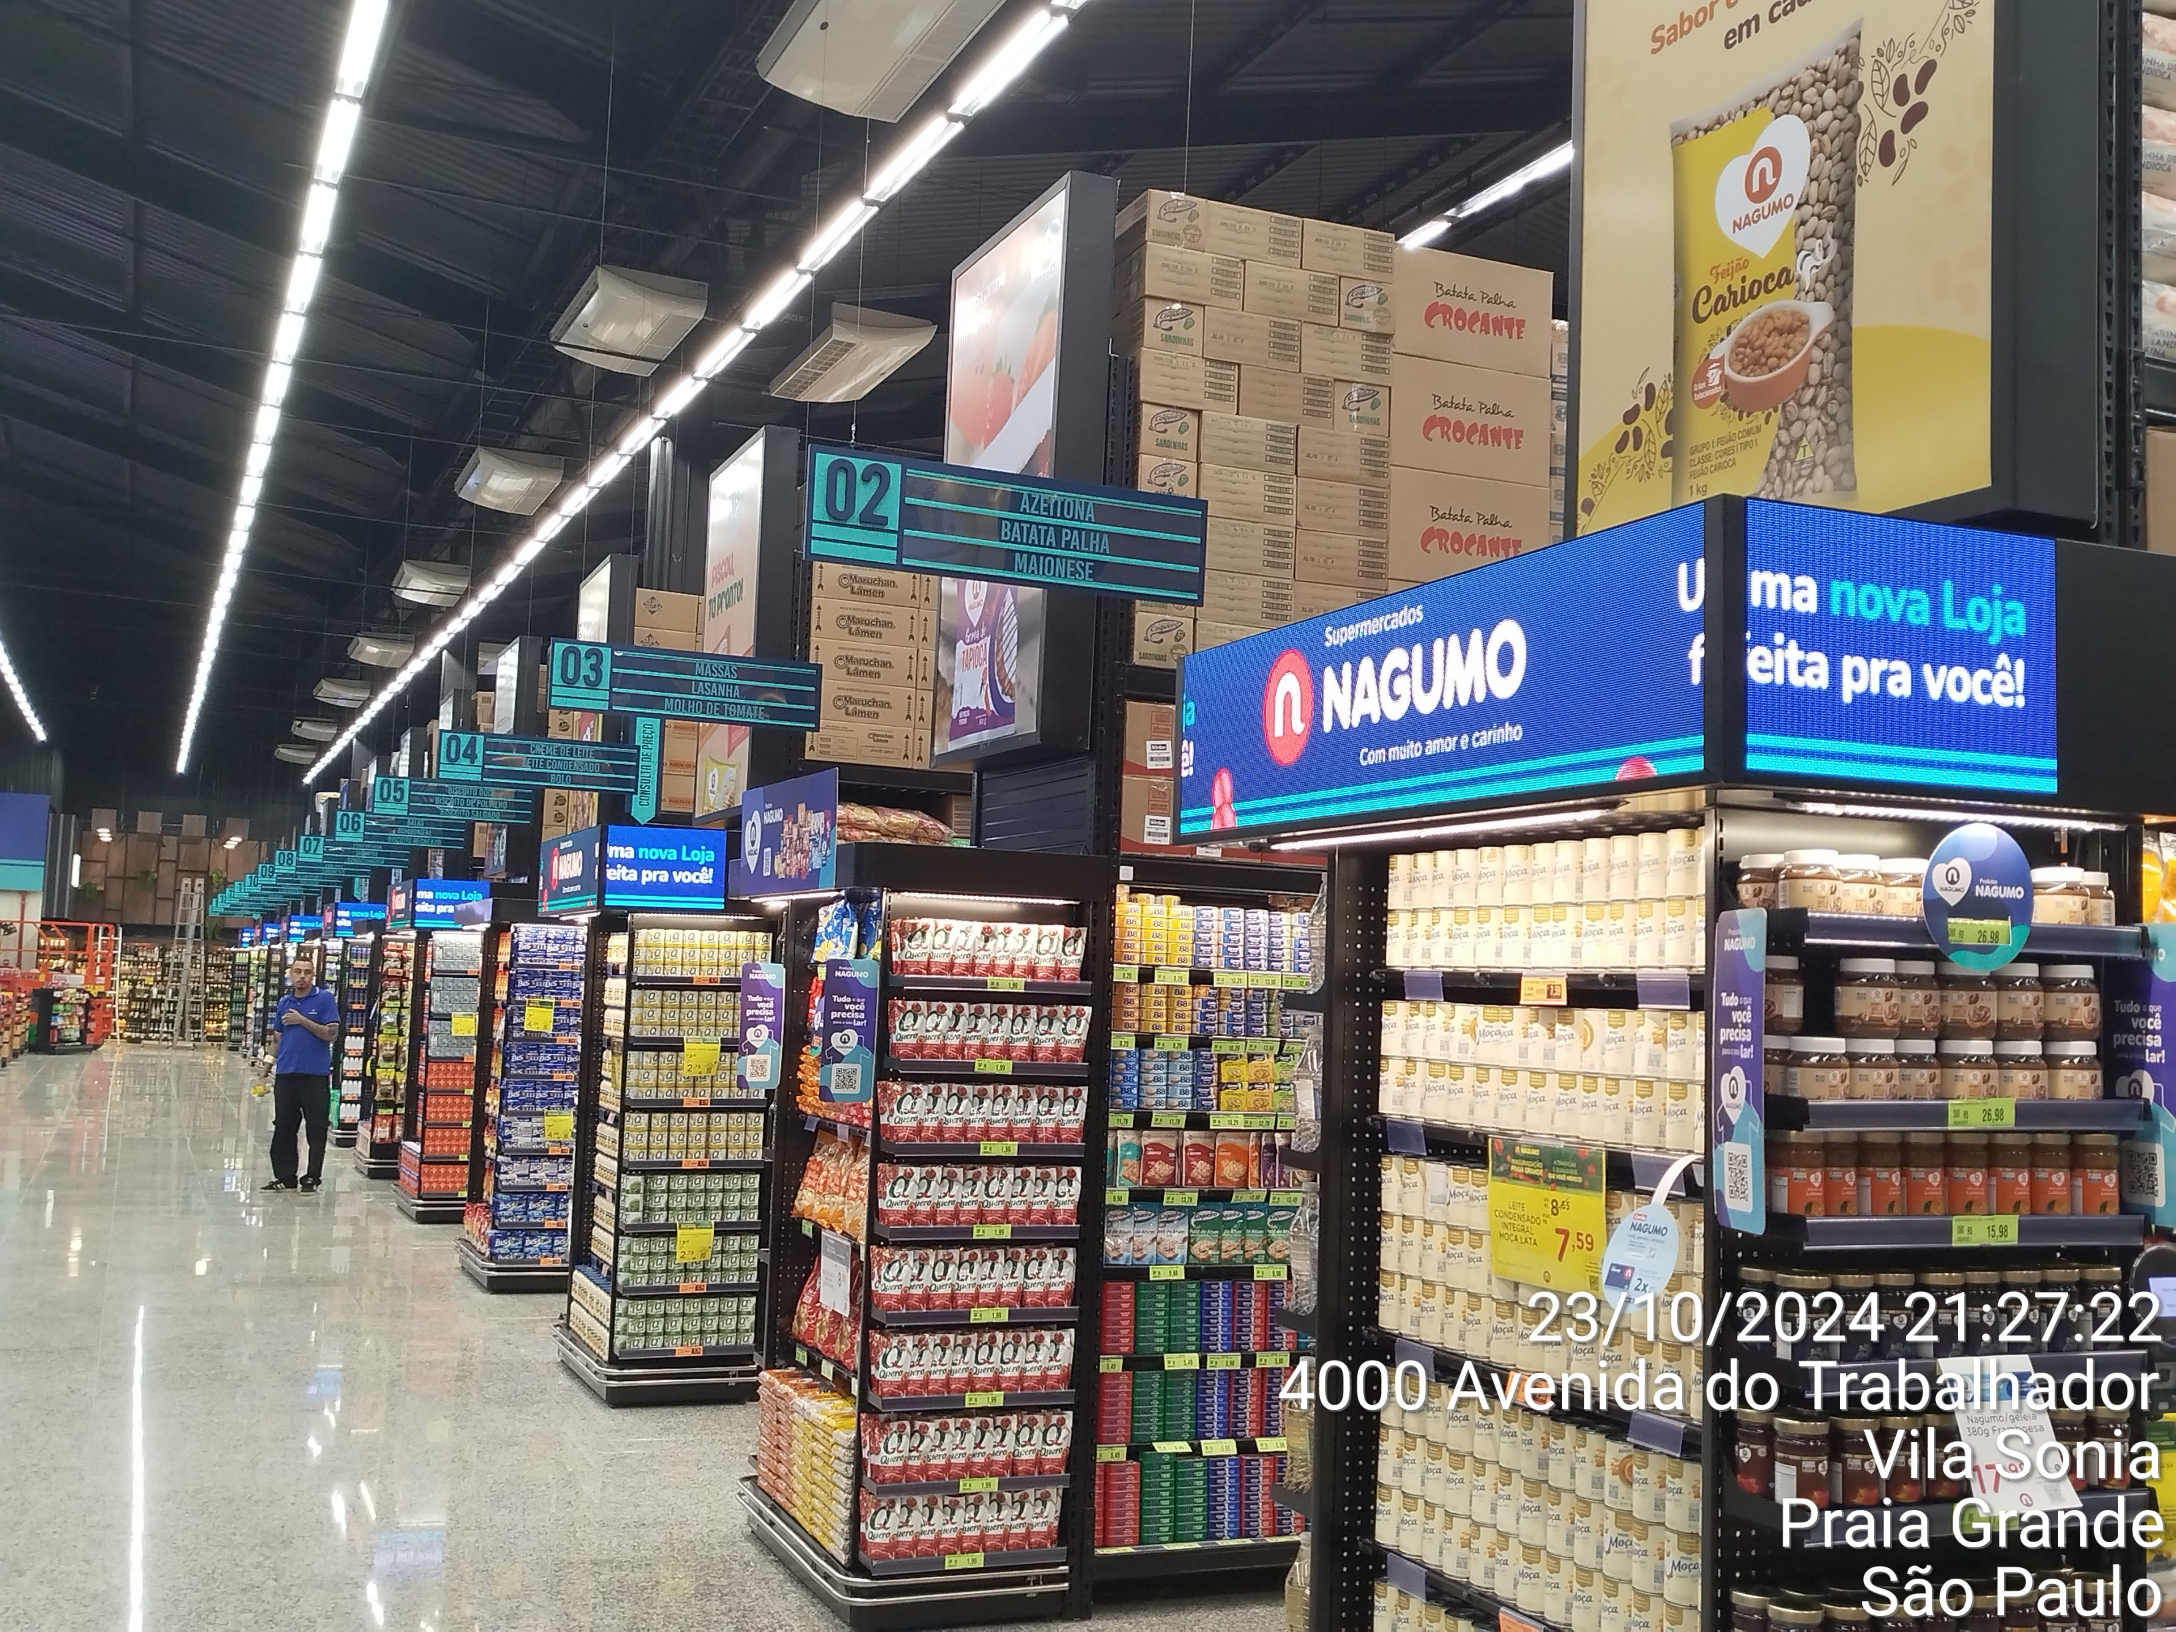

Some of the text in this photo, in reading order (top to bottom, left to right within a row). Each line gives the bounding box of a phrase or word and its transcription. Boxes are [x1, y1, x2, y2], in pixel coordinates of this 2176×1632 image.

[1651, 0, 1721, 54] Sabor
[1724, 13, 1760, 50] em
[1732, 193, 1795, 234] NAGUMO
[1709, 256, 1750, 284] Feijão
[1434, 281, 1517, 309] Batata Palha
[1692, 266, 1795, 324] Carioca
[1424, 301, 1526, 340] CROCANTE
[1431, 393, 1515, 419] Batata Palha
[1422, 414, 1525, 450] CROCANTE
[1738, 423, 1762, 441] COMUM
[1710, 457, 1736, 475] CARIOCA
[825, 457, 891, 526] 02
[1019, 492, 1096, 523] AZEITONA
[1429, 505, 1513, 529] Batata Palha
[1000, 520, 1111, 555] BATATA PALHA
[1420, 526, 1523, 559] CROCANTE
[1014, 552, 1094, 582] MAIONESE
[1829, 579, 1930, 625] nova
[1942, 579, 2027, 646] Loja
[1324, 604, 1425, 648] Supermercados
[560, 645, 604, 688] 03
[962, 642, 987, 673] TAPIOCA
[694, 663, 738, 680] MASSAS
[1321, 618, 1527, 733] NAGUMO
[1841, 654, 1913, 703] pra
[1922, 653, 2026, 708] você!
[691, 681, 740, 699] LASANHA
[664, 698, 766, 720] MOLHO DE TOMATE
[445, 734, 478, 764] 04
[530, 744, 595, 759] CREME DE LEITE
[1359, 721, 1524, 766] Com muito amor e carinho
[546, 759, 601, 773] CONDENSADO
[639, 723, 654, 807] CONSULTA DE PREÇO
[551, 774, 572, 785] BOLO
[379, 779, 406, 803] 05
[340, 815, 361, 832] 06
[303, 837, 320, 854] 07
[638, 846, 678, 861] nova
[682, 845, 715, 862] Loja
[278, 851, 294, 866] 08
[641, 867, 669, 886] pra
[672, 865, 714, 884] você!
[435, 890, 459, 901] nova
[461, 888, 483, 902] Loja
[1939, 886, 1965, 894] NAGUMO
[1975, 884, 2025, 899] NAGUMO
[436, 903, 455, 914] pra
[1724, 936, 1756, 951] NAGUMO
[835, 969, 869, 978] NAGUMO
[832, 995, 851, 1003] Tudo
[844, 1002, 866, 1012] você
[1721, 993, 1739, 1007] Tudo
[2114, 1000, 2140, 1013] Tudo
[2148, 1004, 2162, 1016] que
[831, 1010, 865, 1020] precisa
[1731, 1005, 1752, 1024] você
[2131, 1012, 2162, 1030] você
[1720, 1024, 1752, 1044] precisa
[2113, 1031, 2162, 1048] precisa
[2145, 1049, 2166, 1064] lar!
[1982, 1107, 2005, 1123] 26,98
[1508, 1200, 1526, 1212] LEITE
[1494, 1208, 1542, 1226] CONDENSADO
[1501, 1222, 1535, 1236] INTEGRAL
[1630, 1221, 1669, 1237] NAGUMO
[1986, 1224, 2009, 1239] 15,98
[1499, 1231, 1539, 1247] MOÇA LATA
[1555, 1227, 1595, 1263] 7,59
[1633, 1277, 1650, 1294] 2x
[1966, 1426, 1990, 1438] 380g
